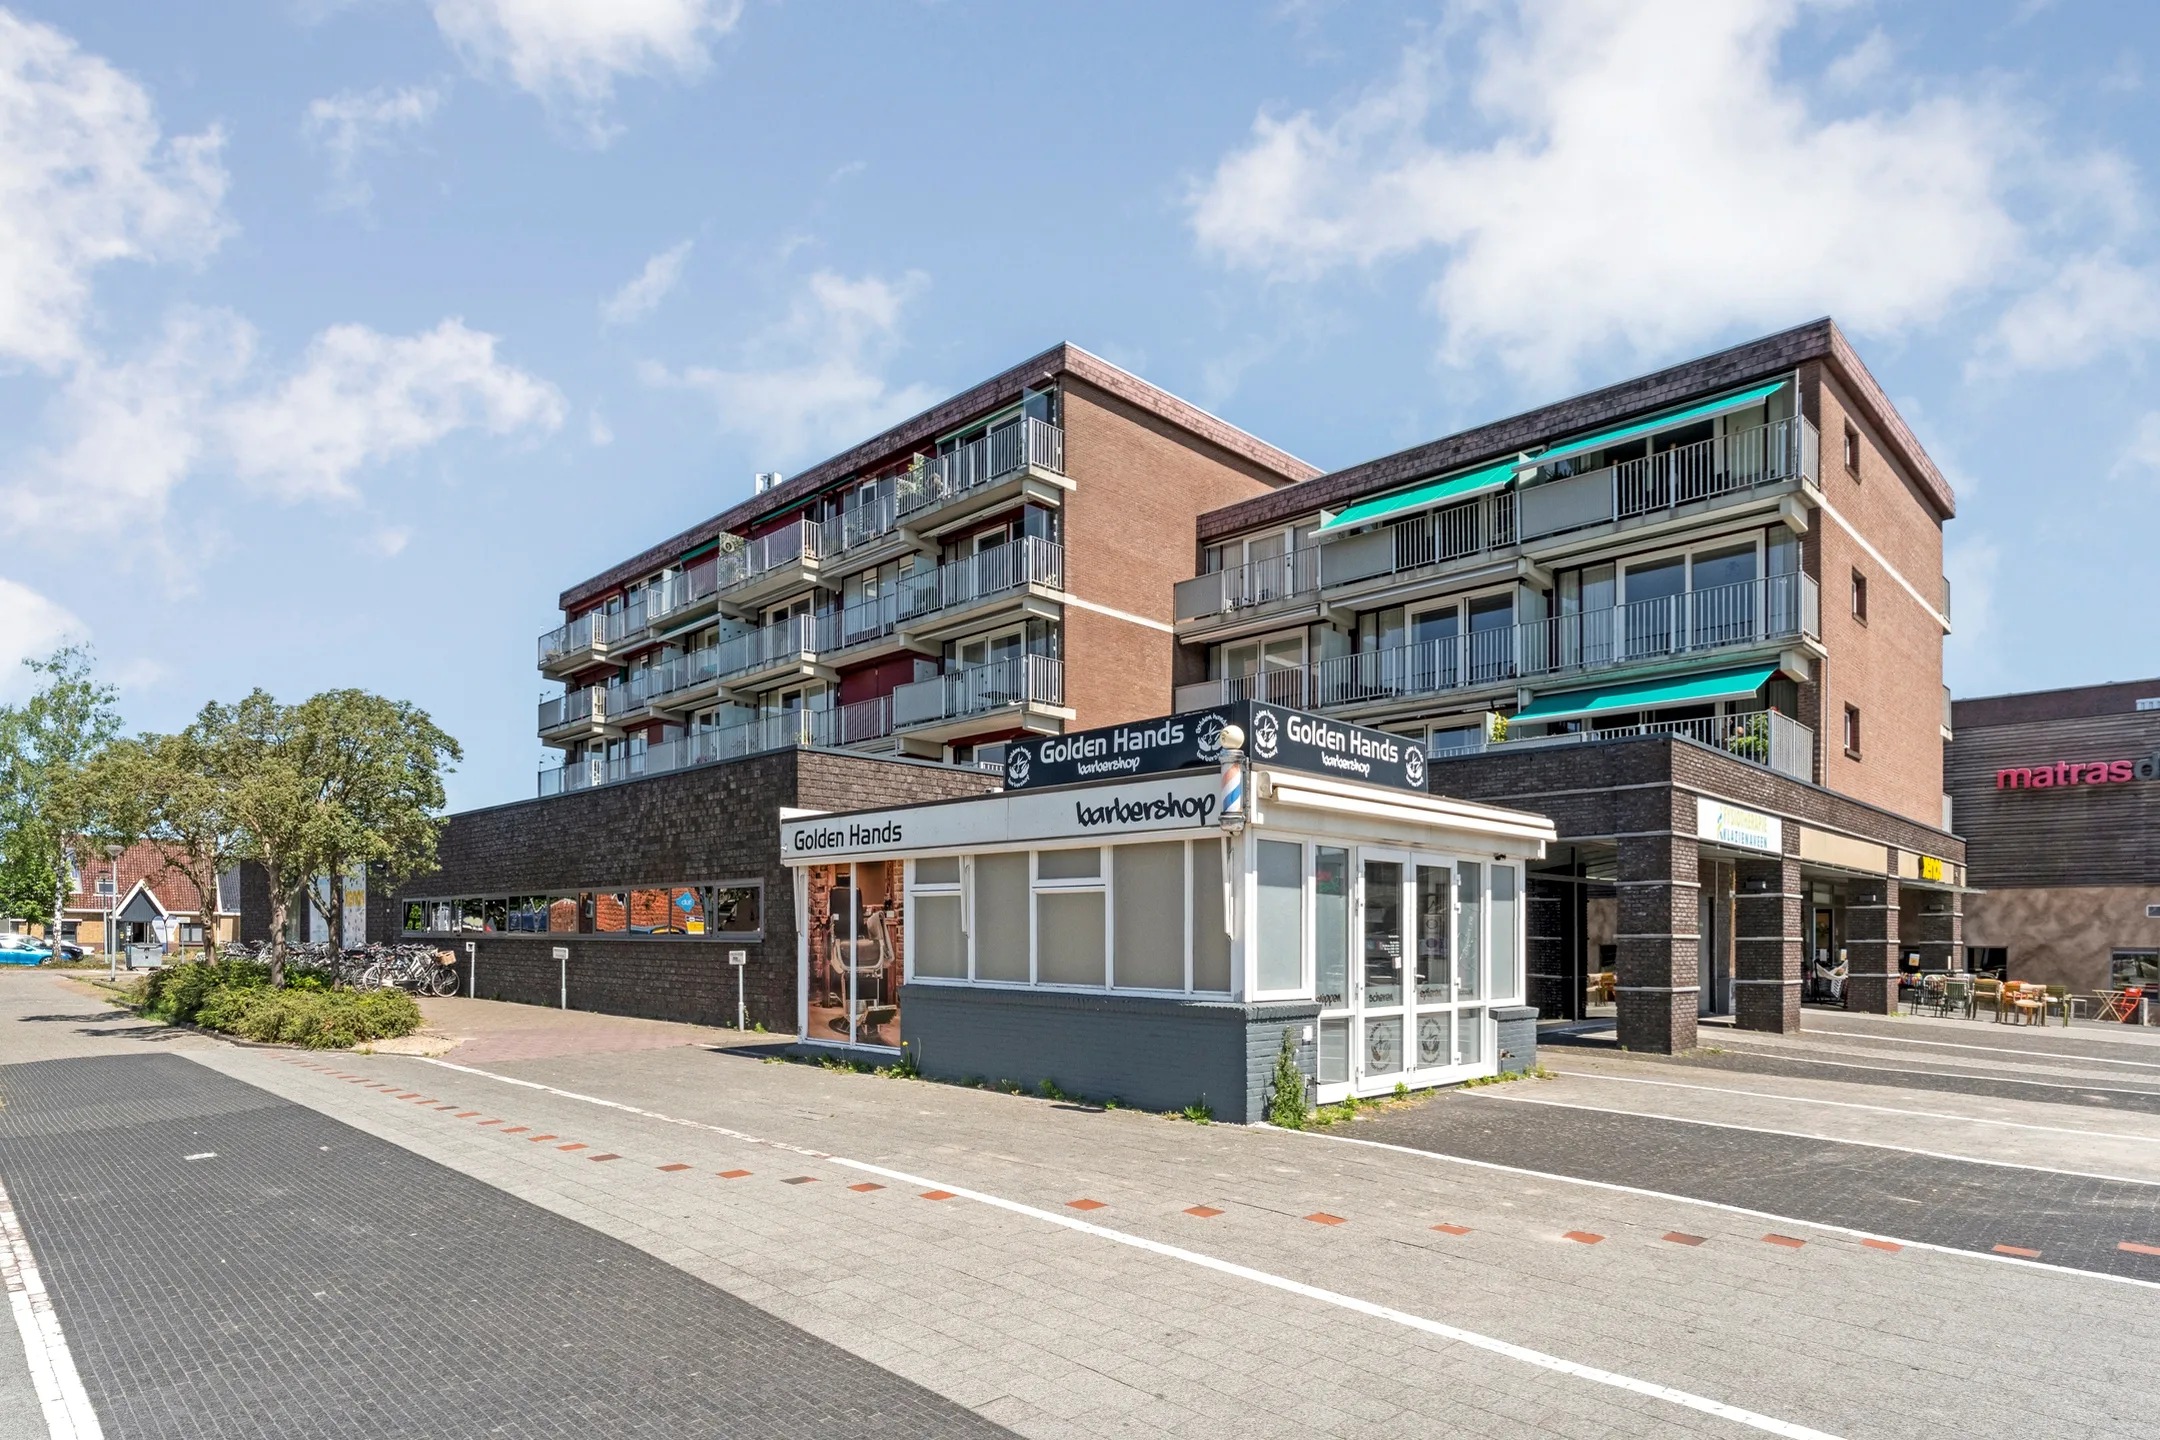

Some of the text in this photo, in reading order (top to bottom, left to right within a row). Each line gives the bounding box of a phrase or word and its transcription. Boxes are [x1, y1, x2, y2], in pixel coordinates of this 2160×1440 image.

[1040, 720, 1184, 764] Golden Hands
[1287, 715, 1346, 752] Golden
[1350, 729, 1399, 764] Hands
[1077, 756, 1141, 776] barbershop
[1321, 751, 1370, 778] barbershop
[1075, 791, 1216, 828] barbershop
[794, 820, 903, 851] Golden Hands
